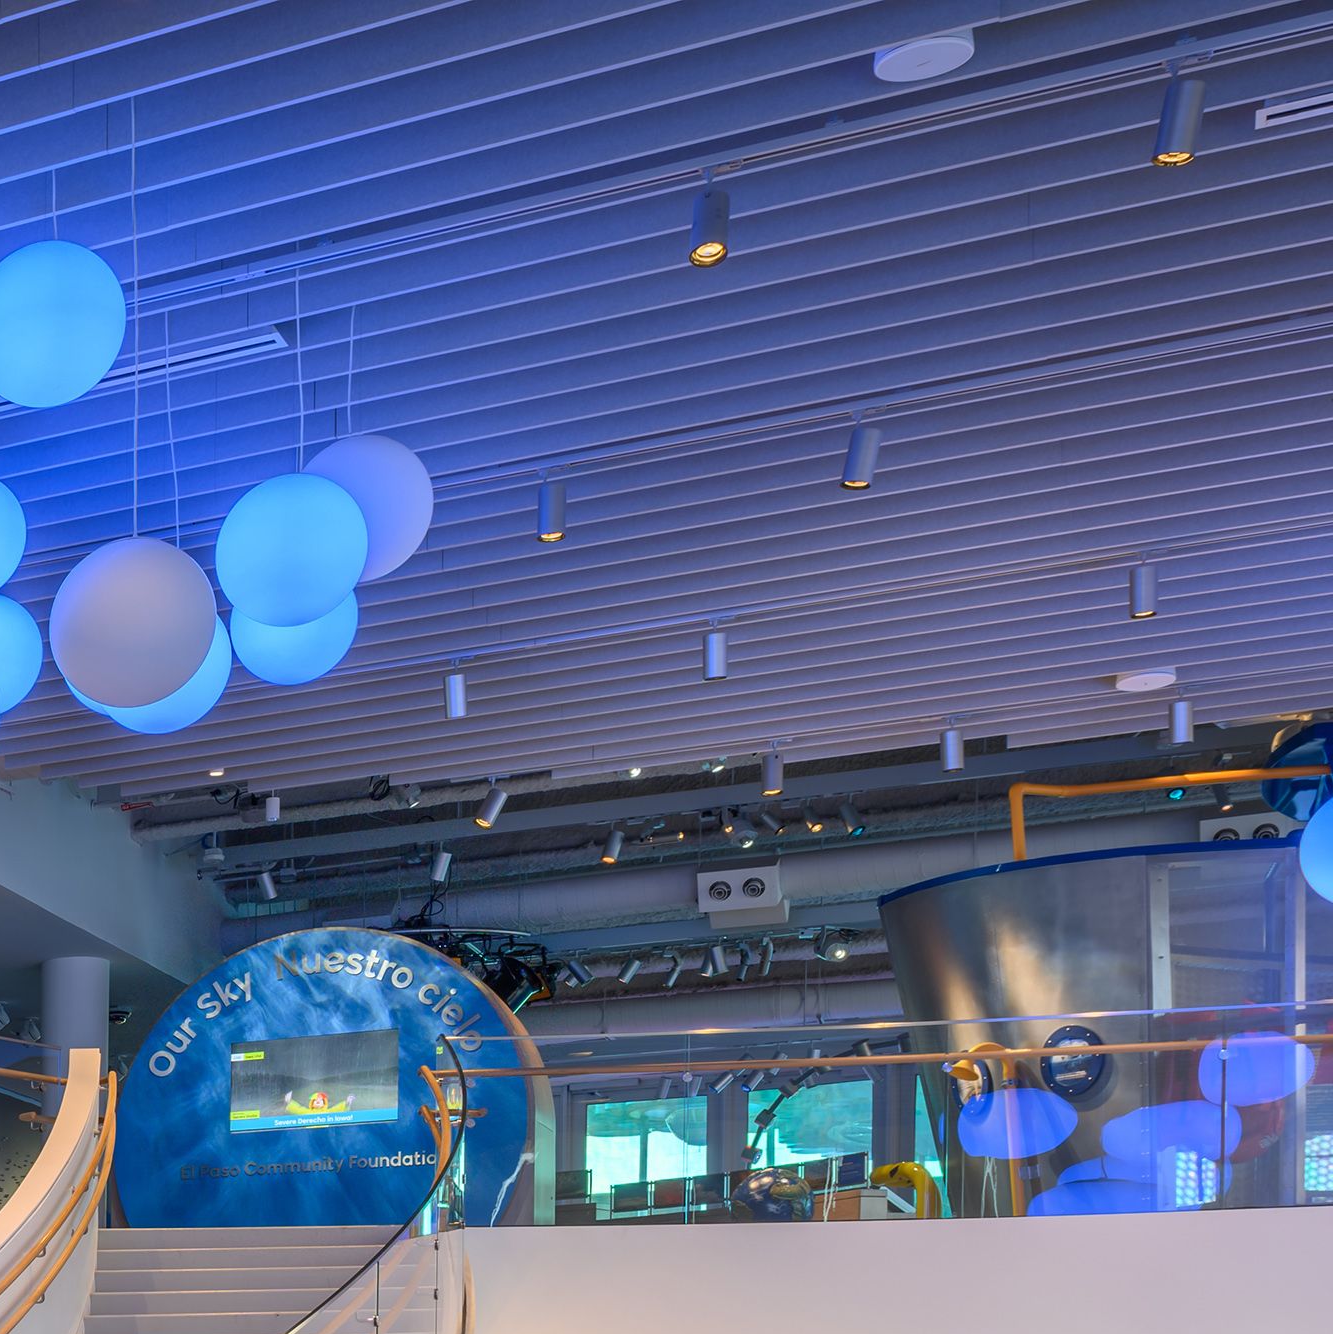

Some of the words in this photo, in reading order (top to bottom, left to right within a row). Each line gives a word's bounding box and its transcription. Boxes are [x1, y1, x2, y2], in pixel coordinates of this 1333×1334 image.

[148, 1016, 198, 1077] Our
[196, 971, 252, 1019] Sky
[274, 949, 413, 989] Nuestro
[181, 1166, 195, 1180] El
[200, 1164, 240, 1178] Paso
[244, 1156, 343, 1176] Community
[348, 1150, 437, 1169] Foundatio
